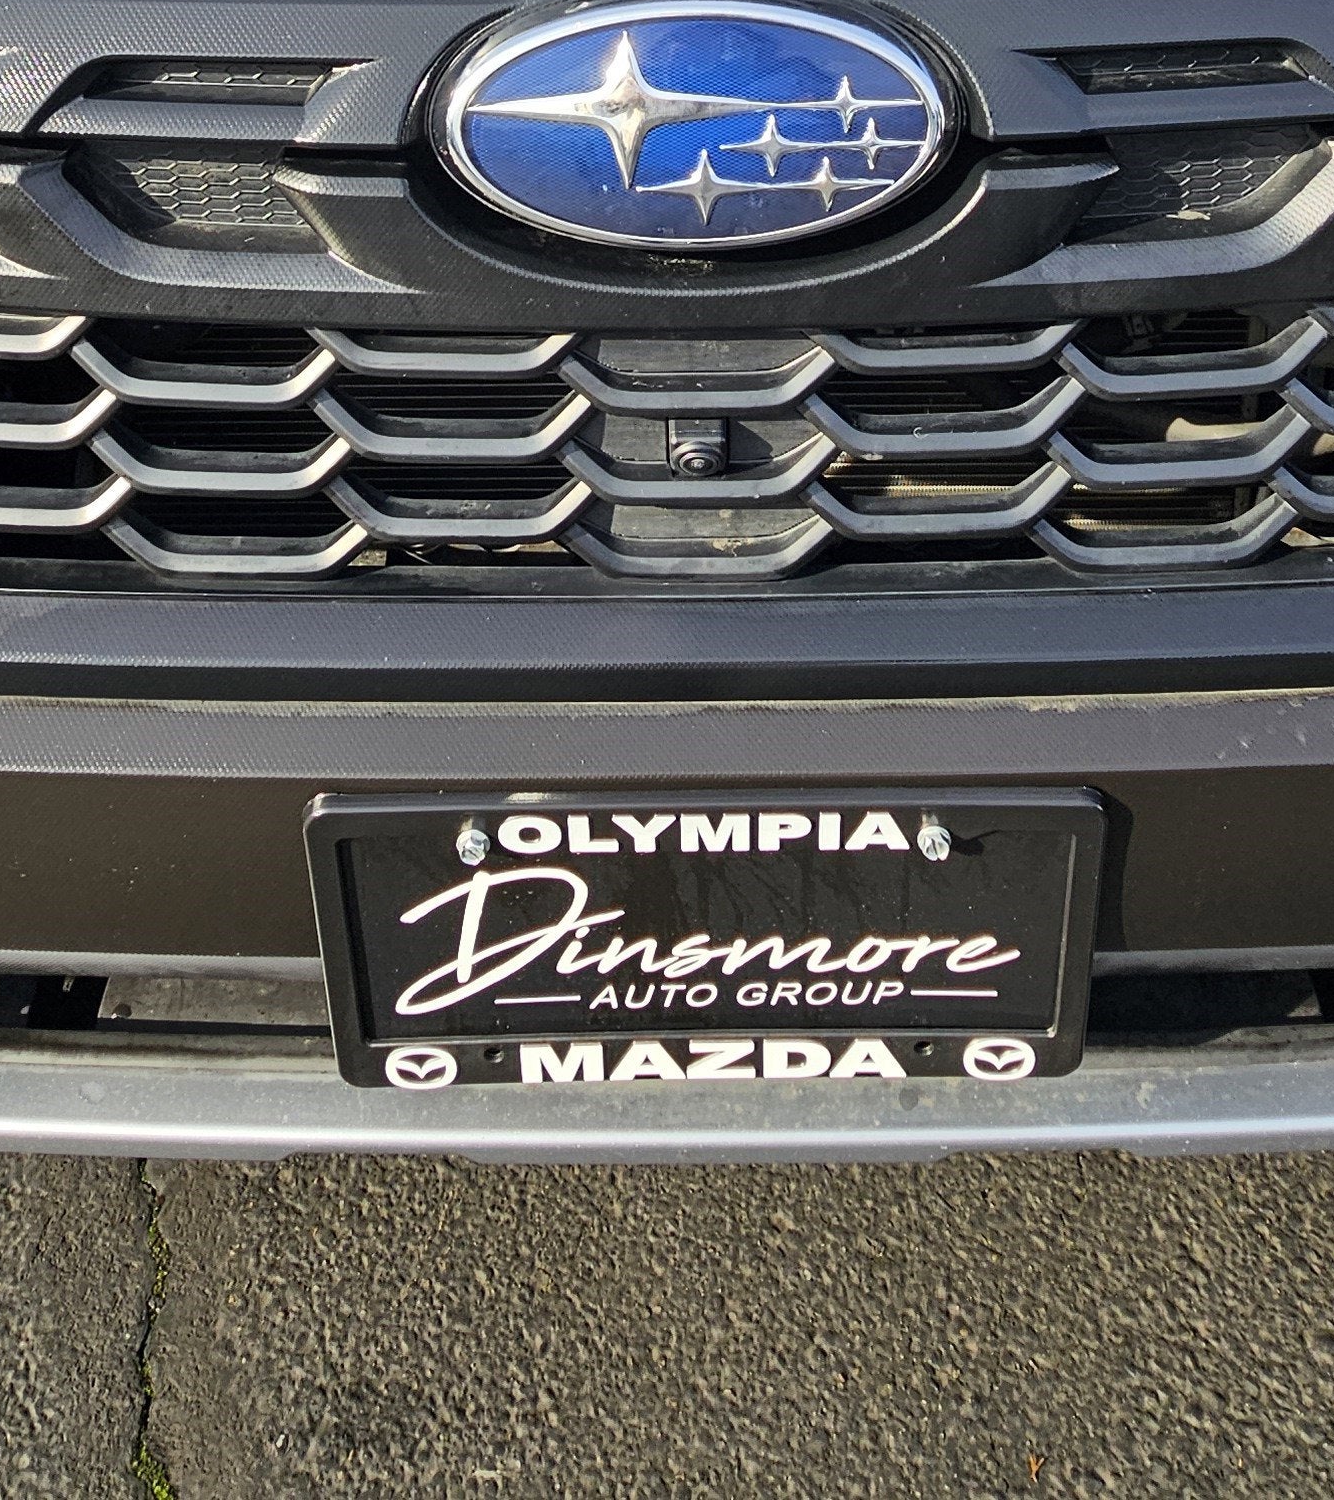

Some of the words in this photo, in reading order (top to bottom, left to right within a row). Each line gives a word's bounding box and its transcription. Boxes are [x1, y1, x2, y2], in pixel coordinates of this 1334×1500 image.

[497, 811, 910, 854] OLYMPIA
[396, 867, 1020, 1016] Dinsmore
[590, 983, 715, 1010] AUTO
[736, 980, 905, 1008] GROUP
[520, 1038, 907, 1084] MAZDA
